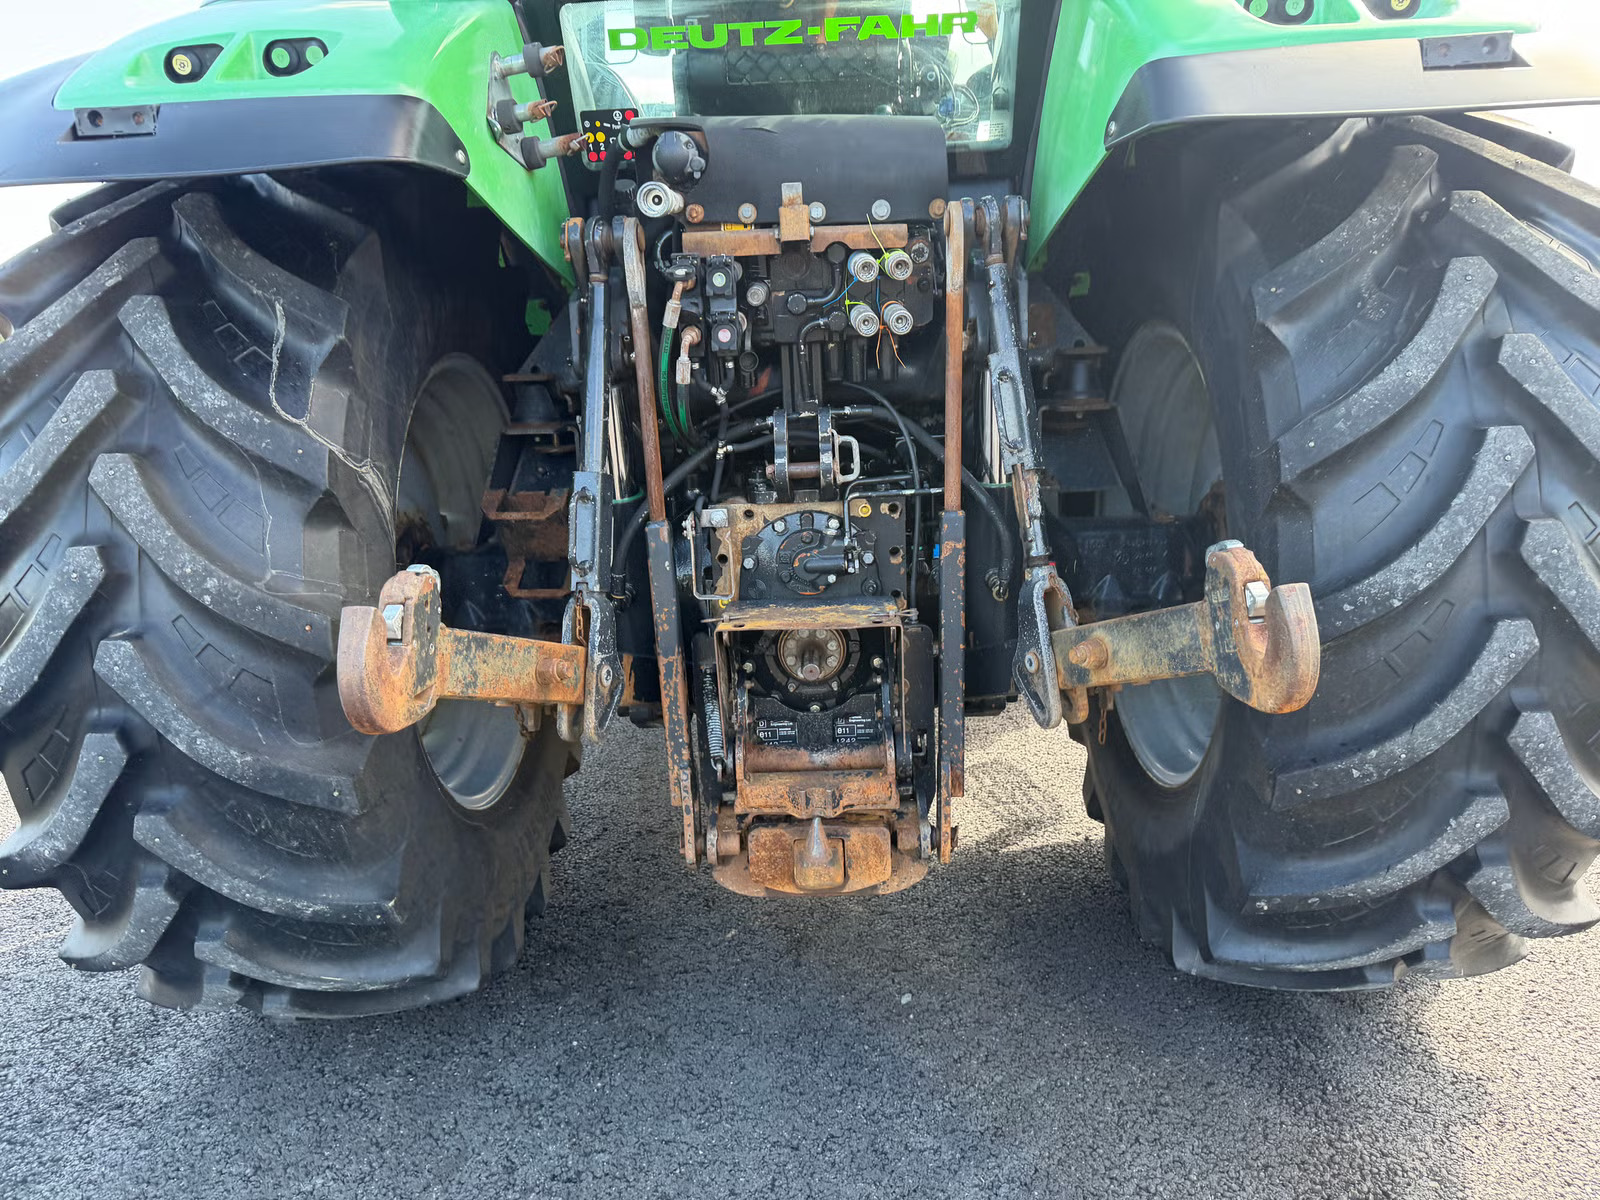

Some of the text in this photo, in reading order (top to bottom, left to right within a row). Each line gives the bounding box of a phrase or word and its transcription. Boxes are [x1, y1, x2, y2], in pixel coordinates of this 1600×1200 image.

[607, 11, 978, 50] DEUTZ-FAHR
[589, 143, 605, 151] 1 2
